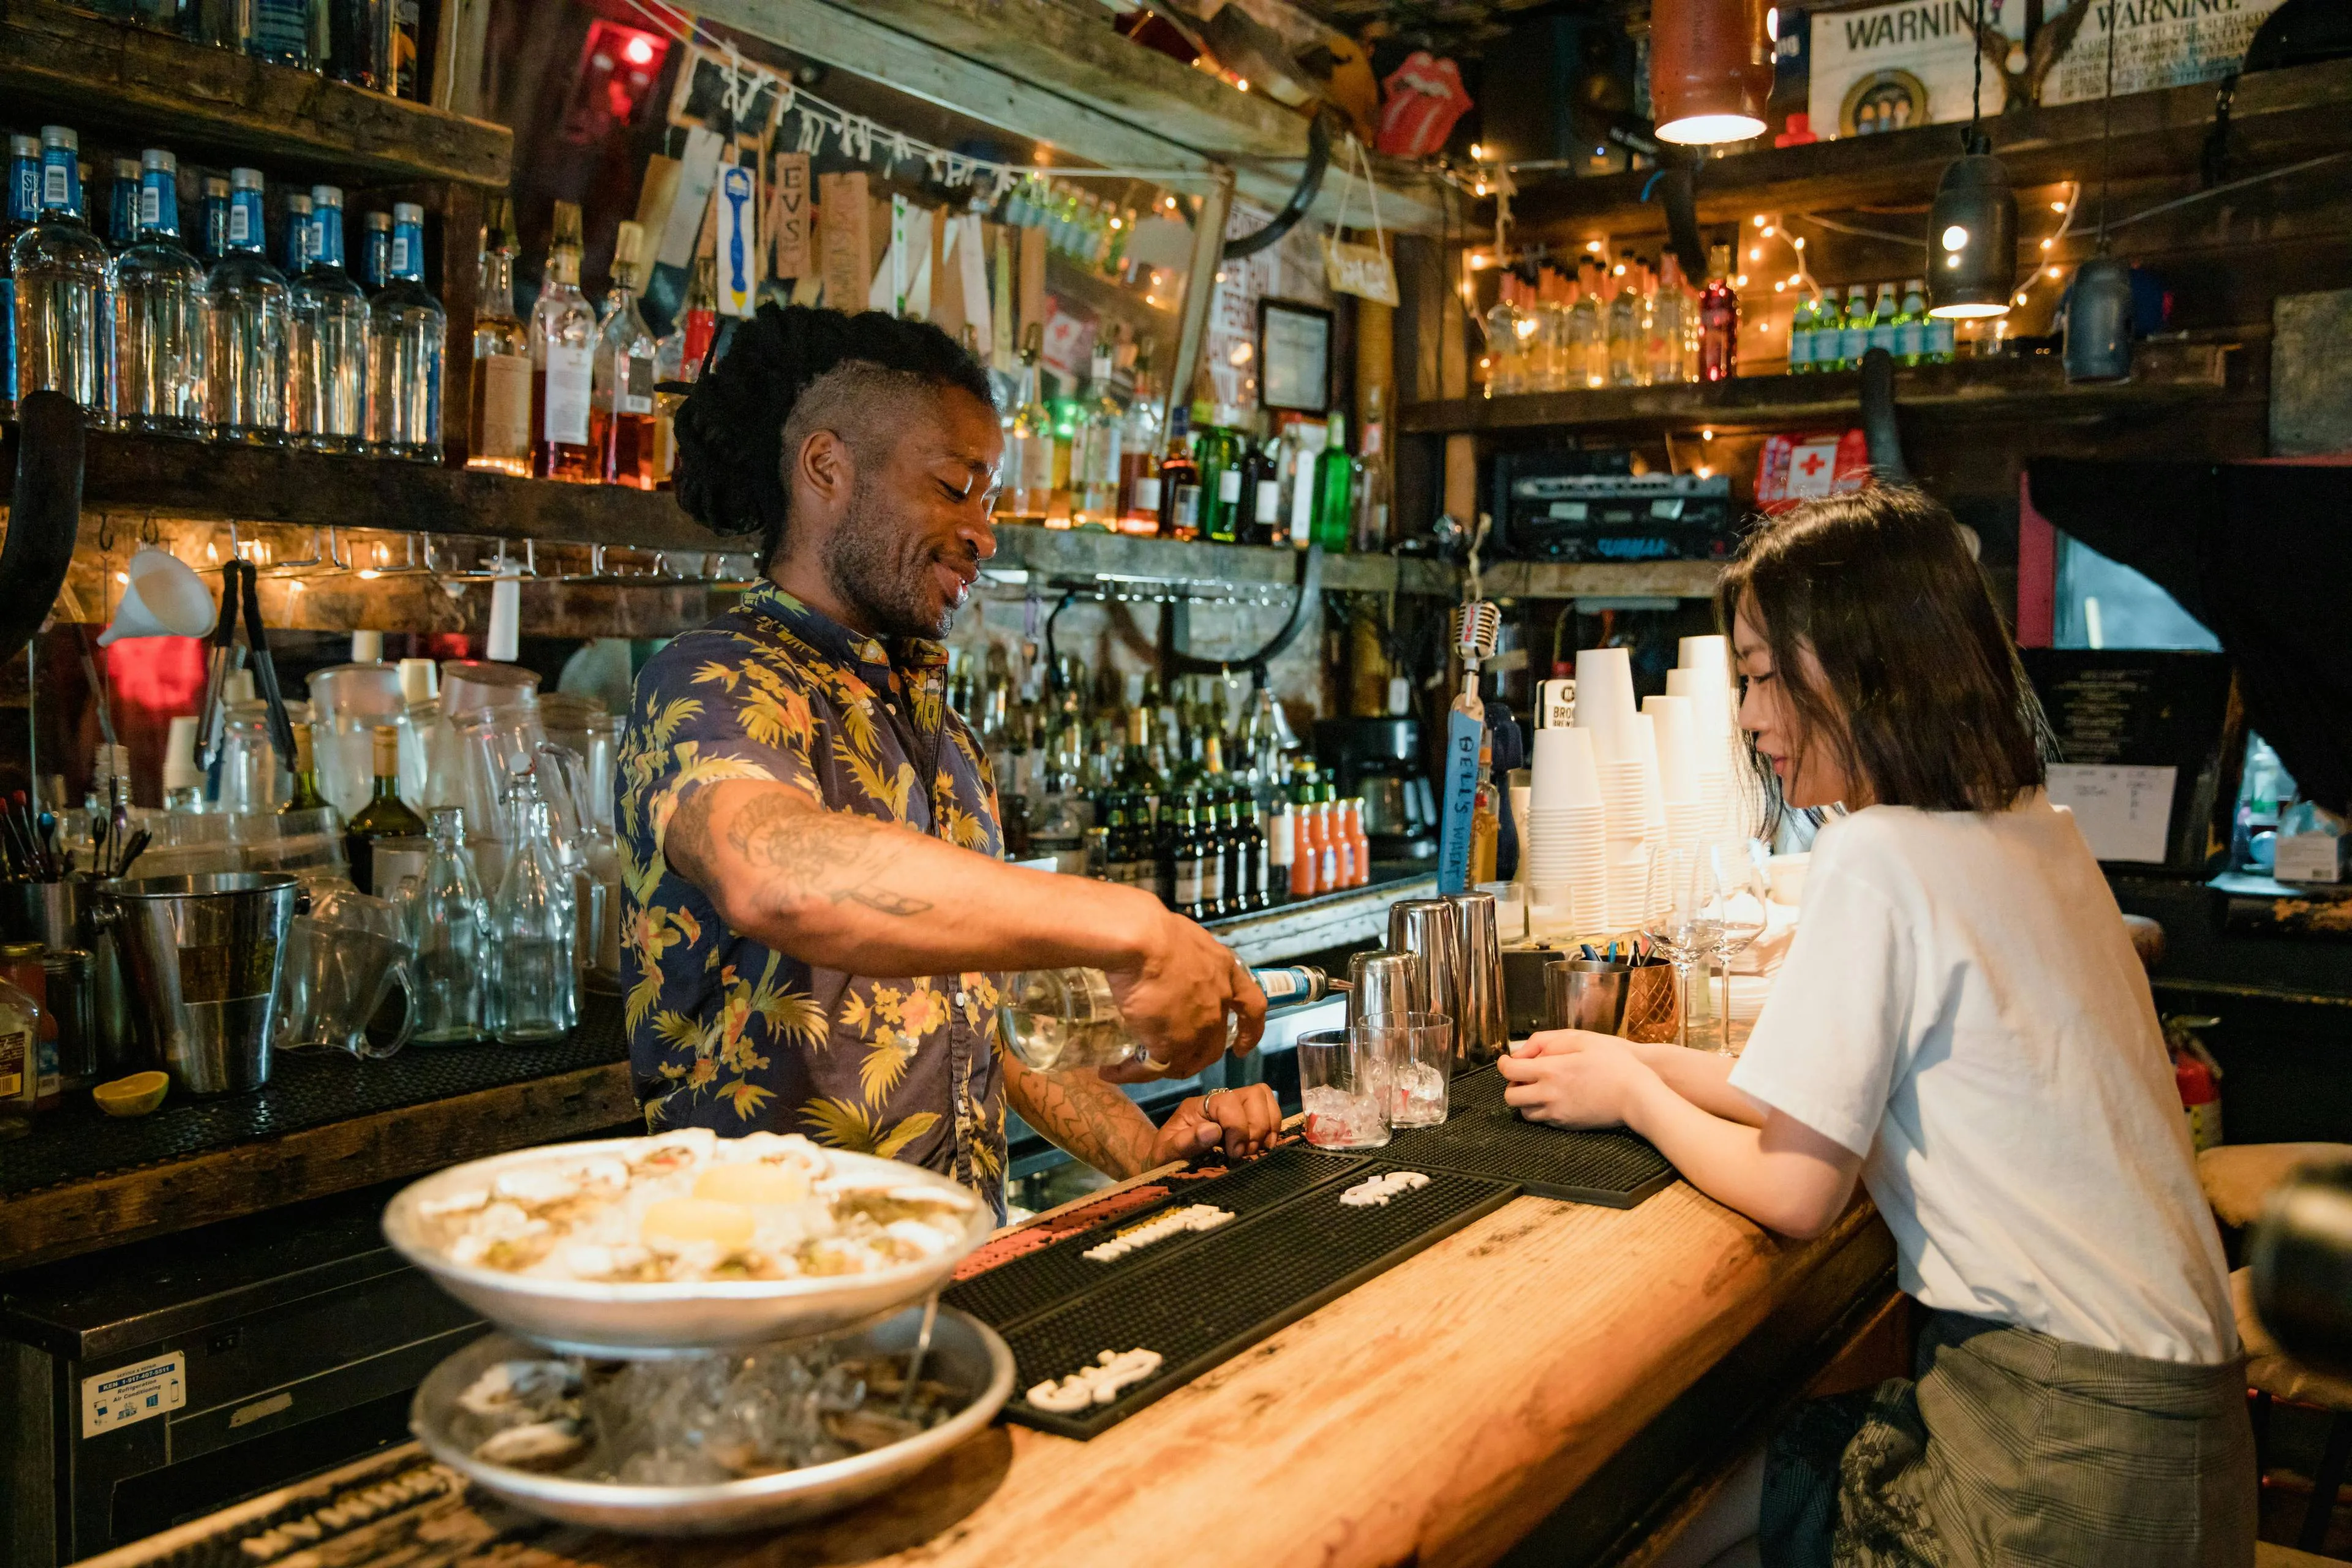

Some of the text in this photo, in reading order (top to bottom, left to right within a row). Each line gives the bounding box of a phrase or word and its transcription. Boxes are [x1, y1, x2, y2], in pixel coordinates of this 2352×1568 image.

[1844, 0, 1974, 51] WARNIN
[1464, 605, 1475, 643] LIVE
[1553, 706, 1574, 718] BRO
[1445, 826, 1464, 876] WHEAT
[117, 1379, 157, 1394] Refrigeration
[123, 1384, 161, 1400] Conditioning
